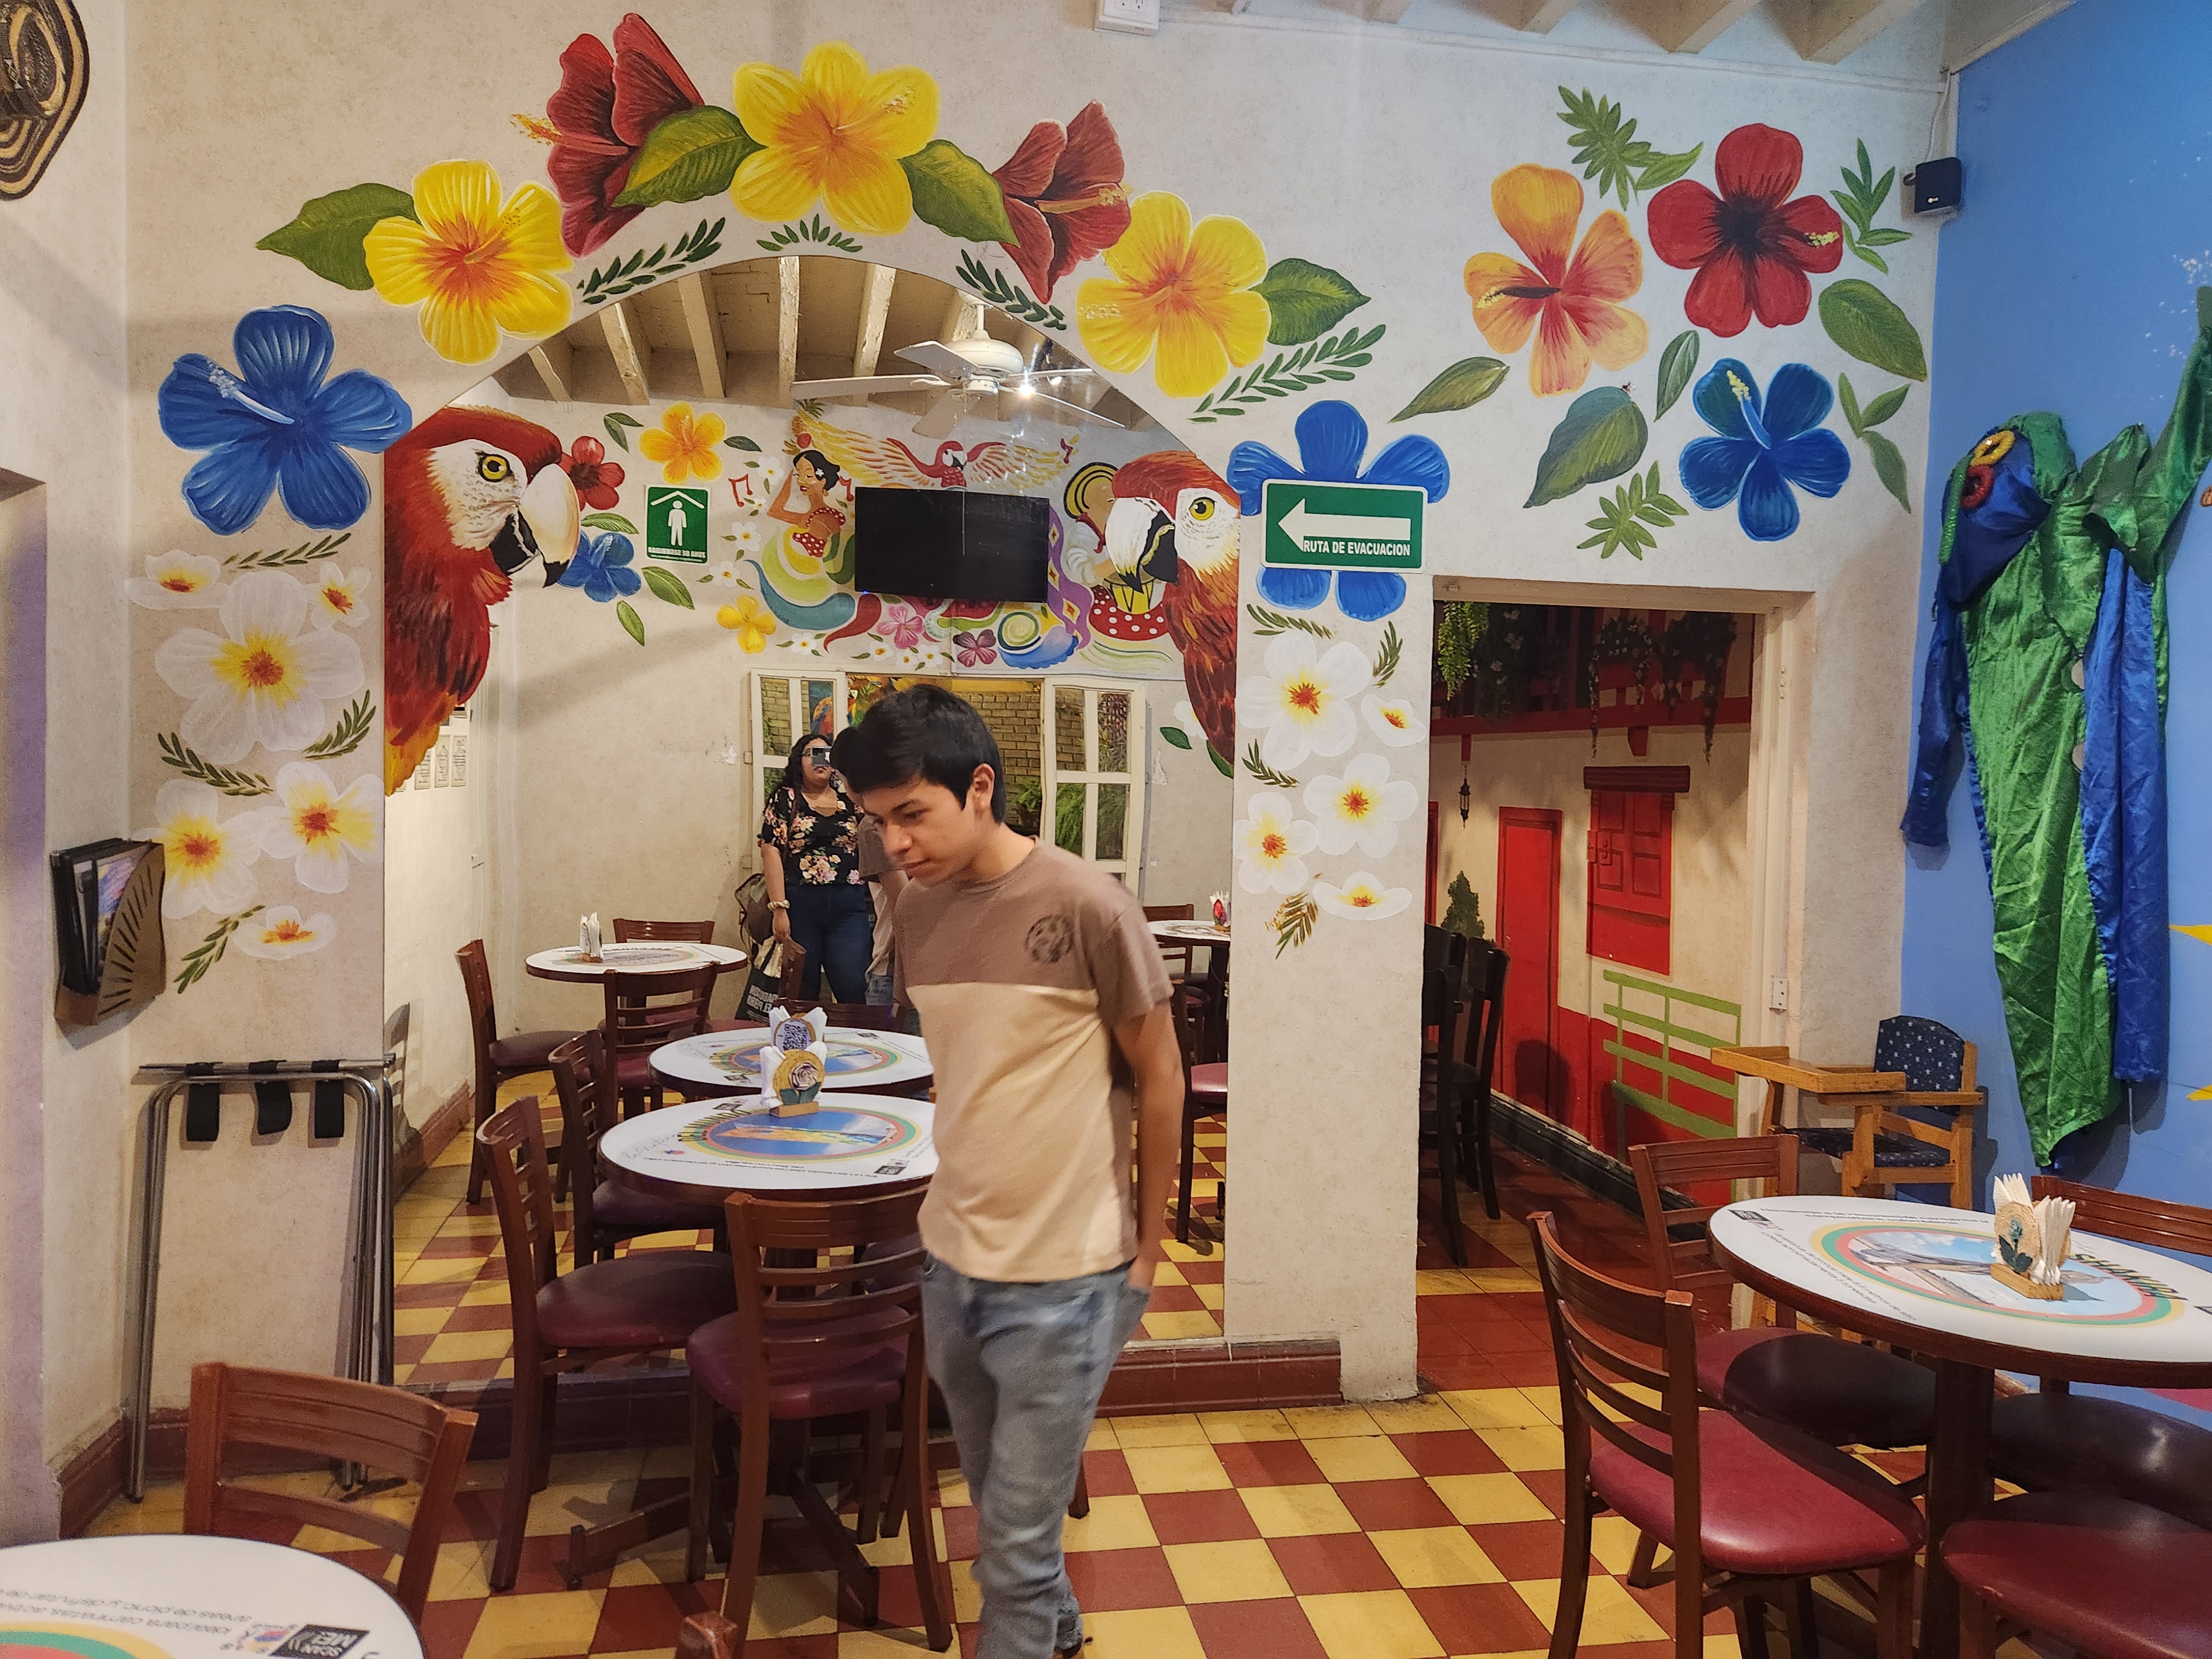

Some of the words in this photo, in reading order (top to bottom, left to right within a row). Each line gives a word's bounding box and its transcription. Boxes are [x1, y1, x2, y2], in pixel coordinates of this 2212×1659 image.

[1303, 540, 1330, 554] RUTA
[1332, 541, 1345, 554] DE
[1347, 541, 1411, 556] EVACUACION
